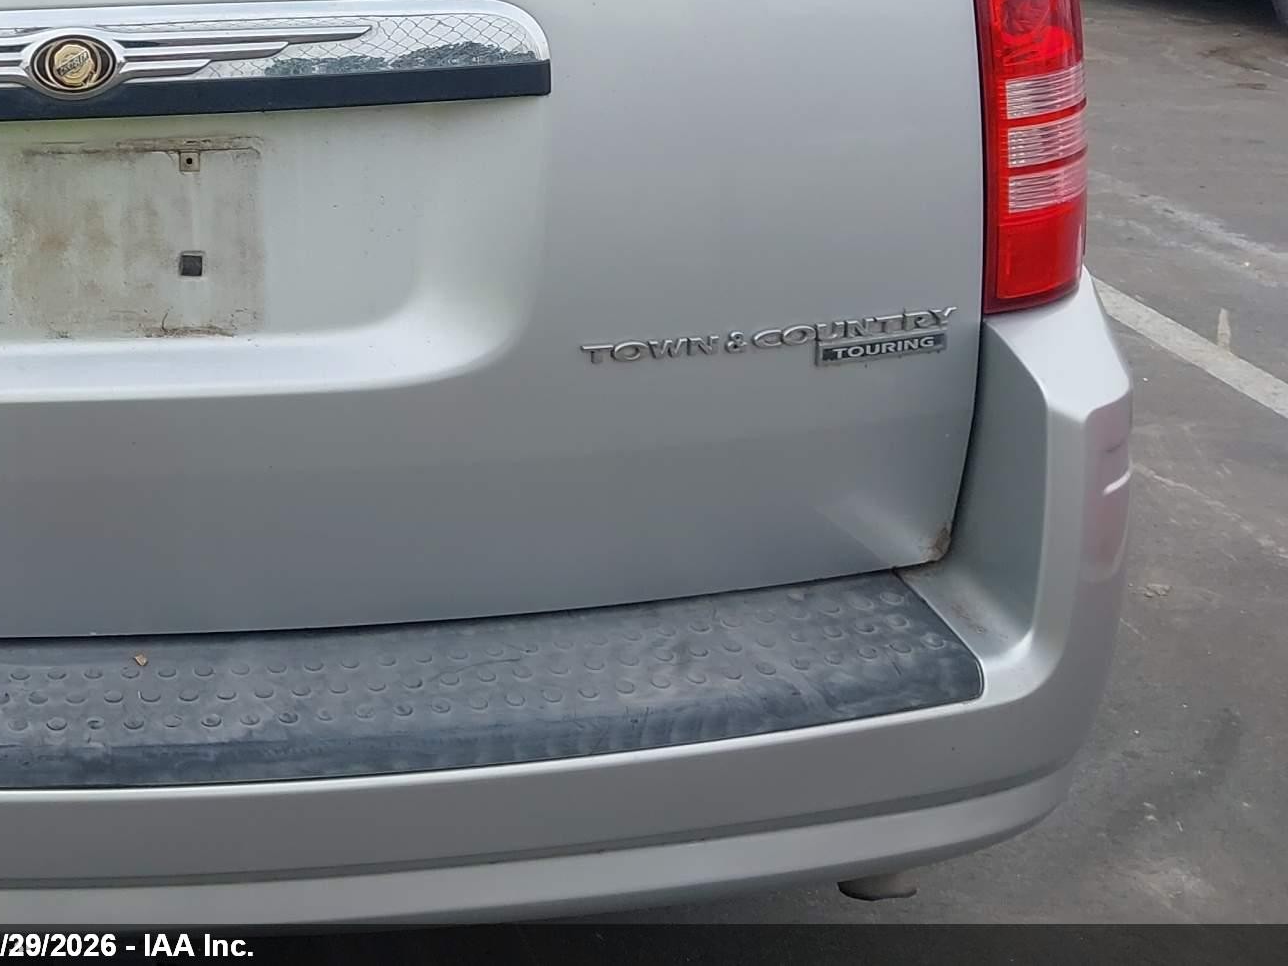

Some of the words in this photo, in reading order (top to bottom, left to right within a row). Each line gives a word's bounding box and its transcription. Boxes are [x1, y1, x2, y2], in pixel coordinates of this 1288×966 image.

[580, 335, 719, 365] TOWN
[726, 331, 747, 354] &
[753, 306, 957, 348] COUNTRY
[833, 336, 936, 361] TOURING
